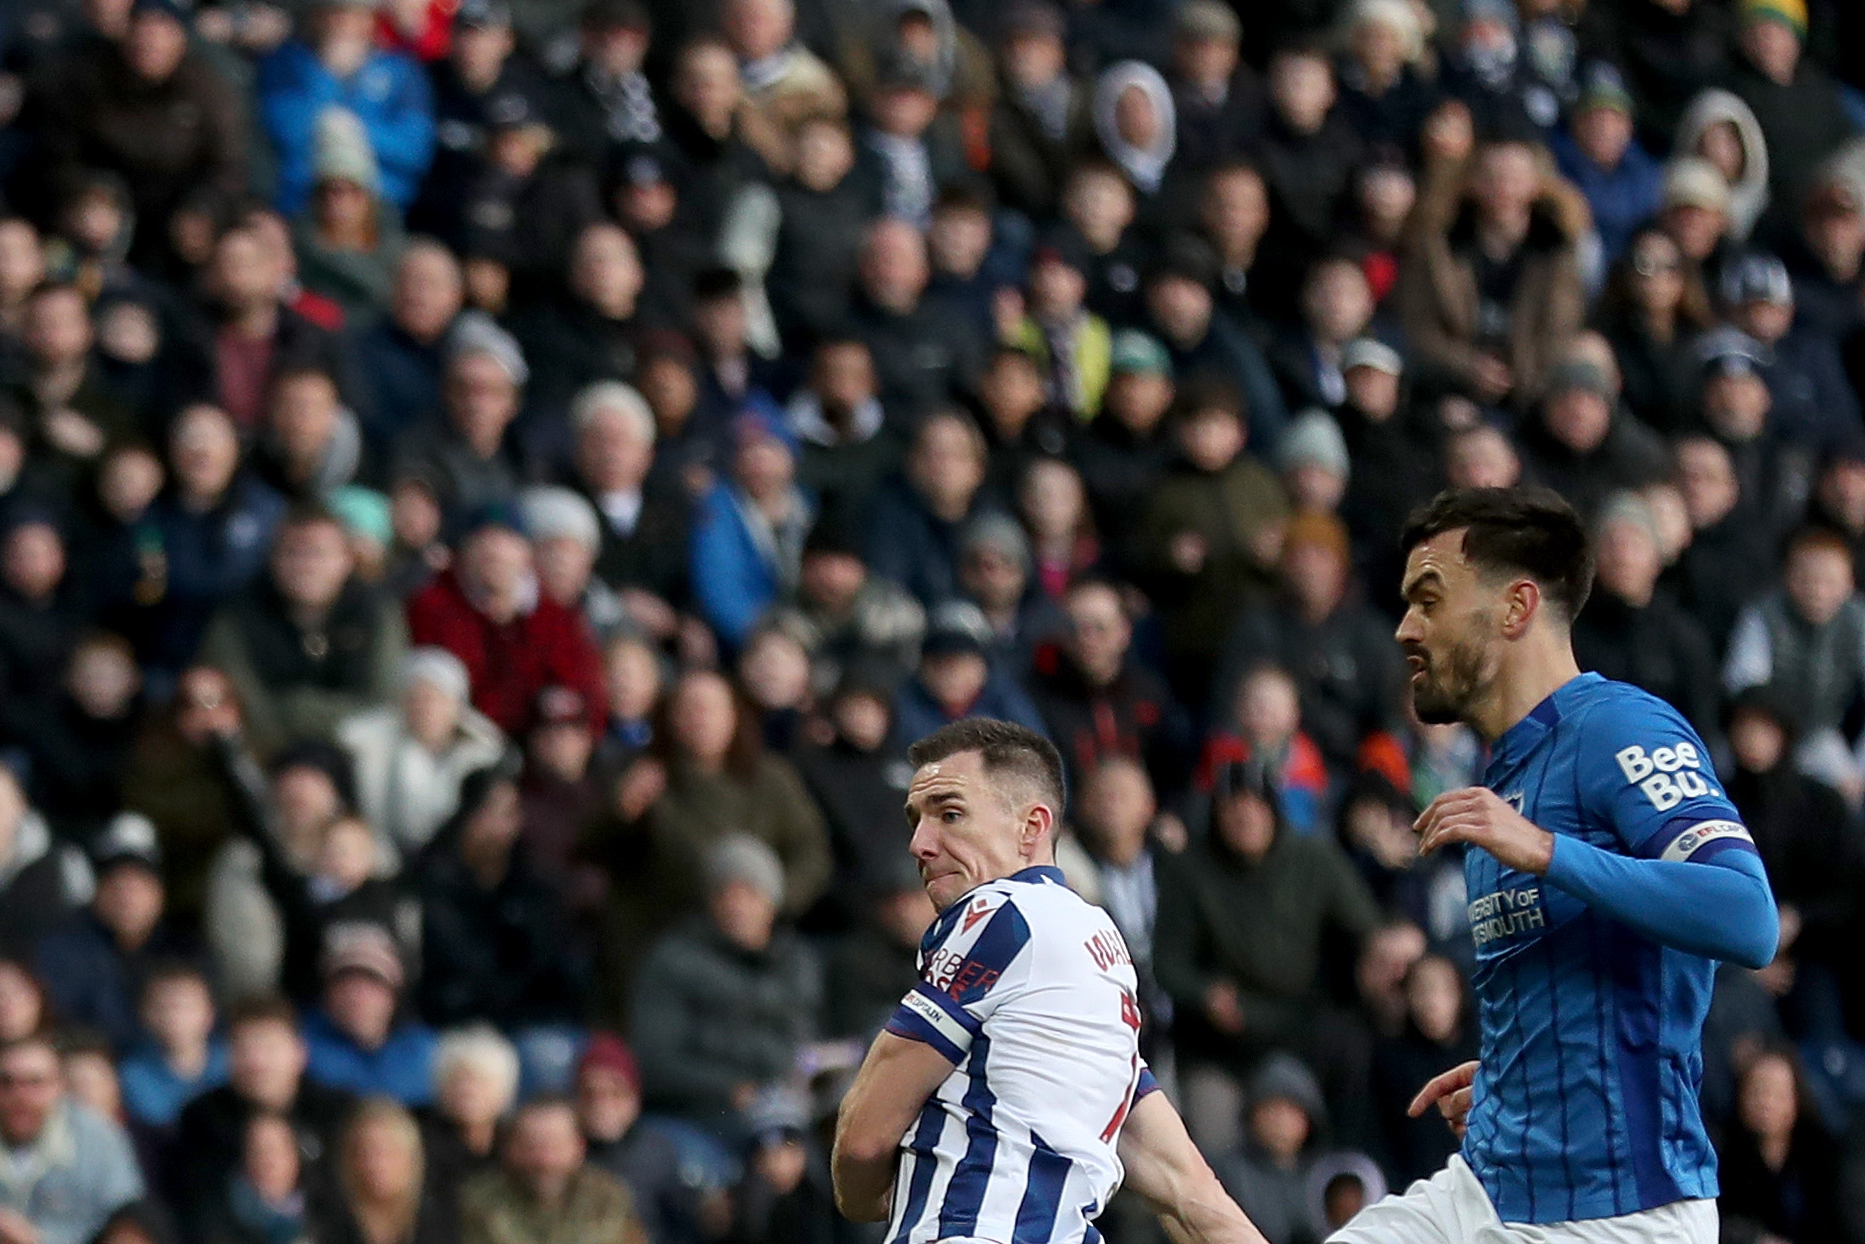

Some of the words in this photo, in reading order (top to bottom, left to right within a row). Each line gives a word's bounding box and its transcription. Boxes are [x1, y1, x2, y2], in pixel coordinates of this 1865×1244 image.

[1615, 741, 1701, 784] Bee
[1639, 770, 1720, 812] Bu.
[1517, 887, 1540, 907] OF
